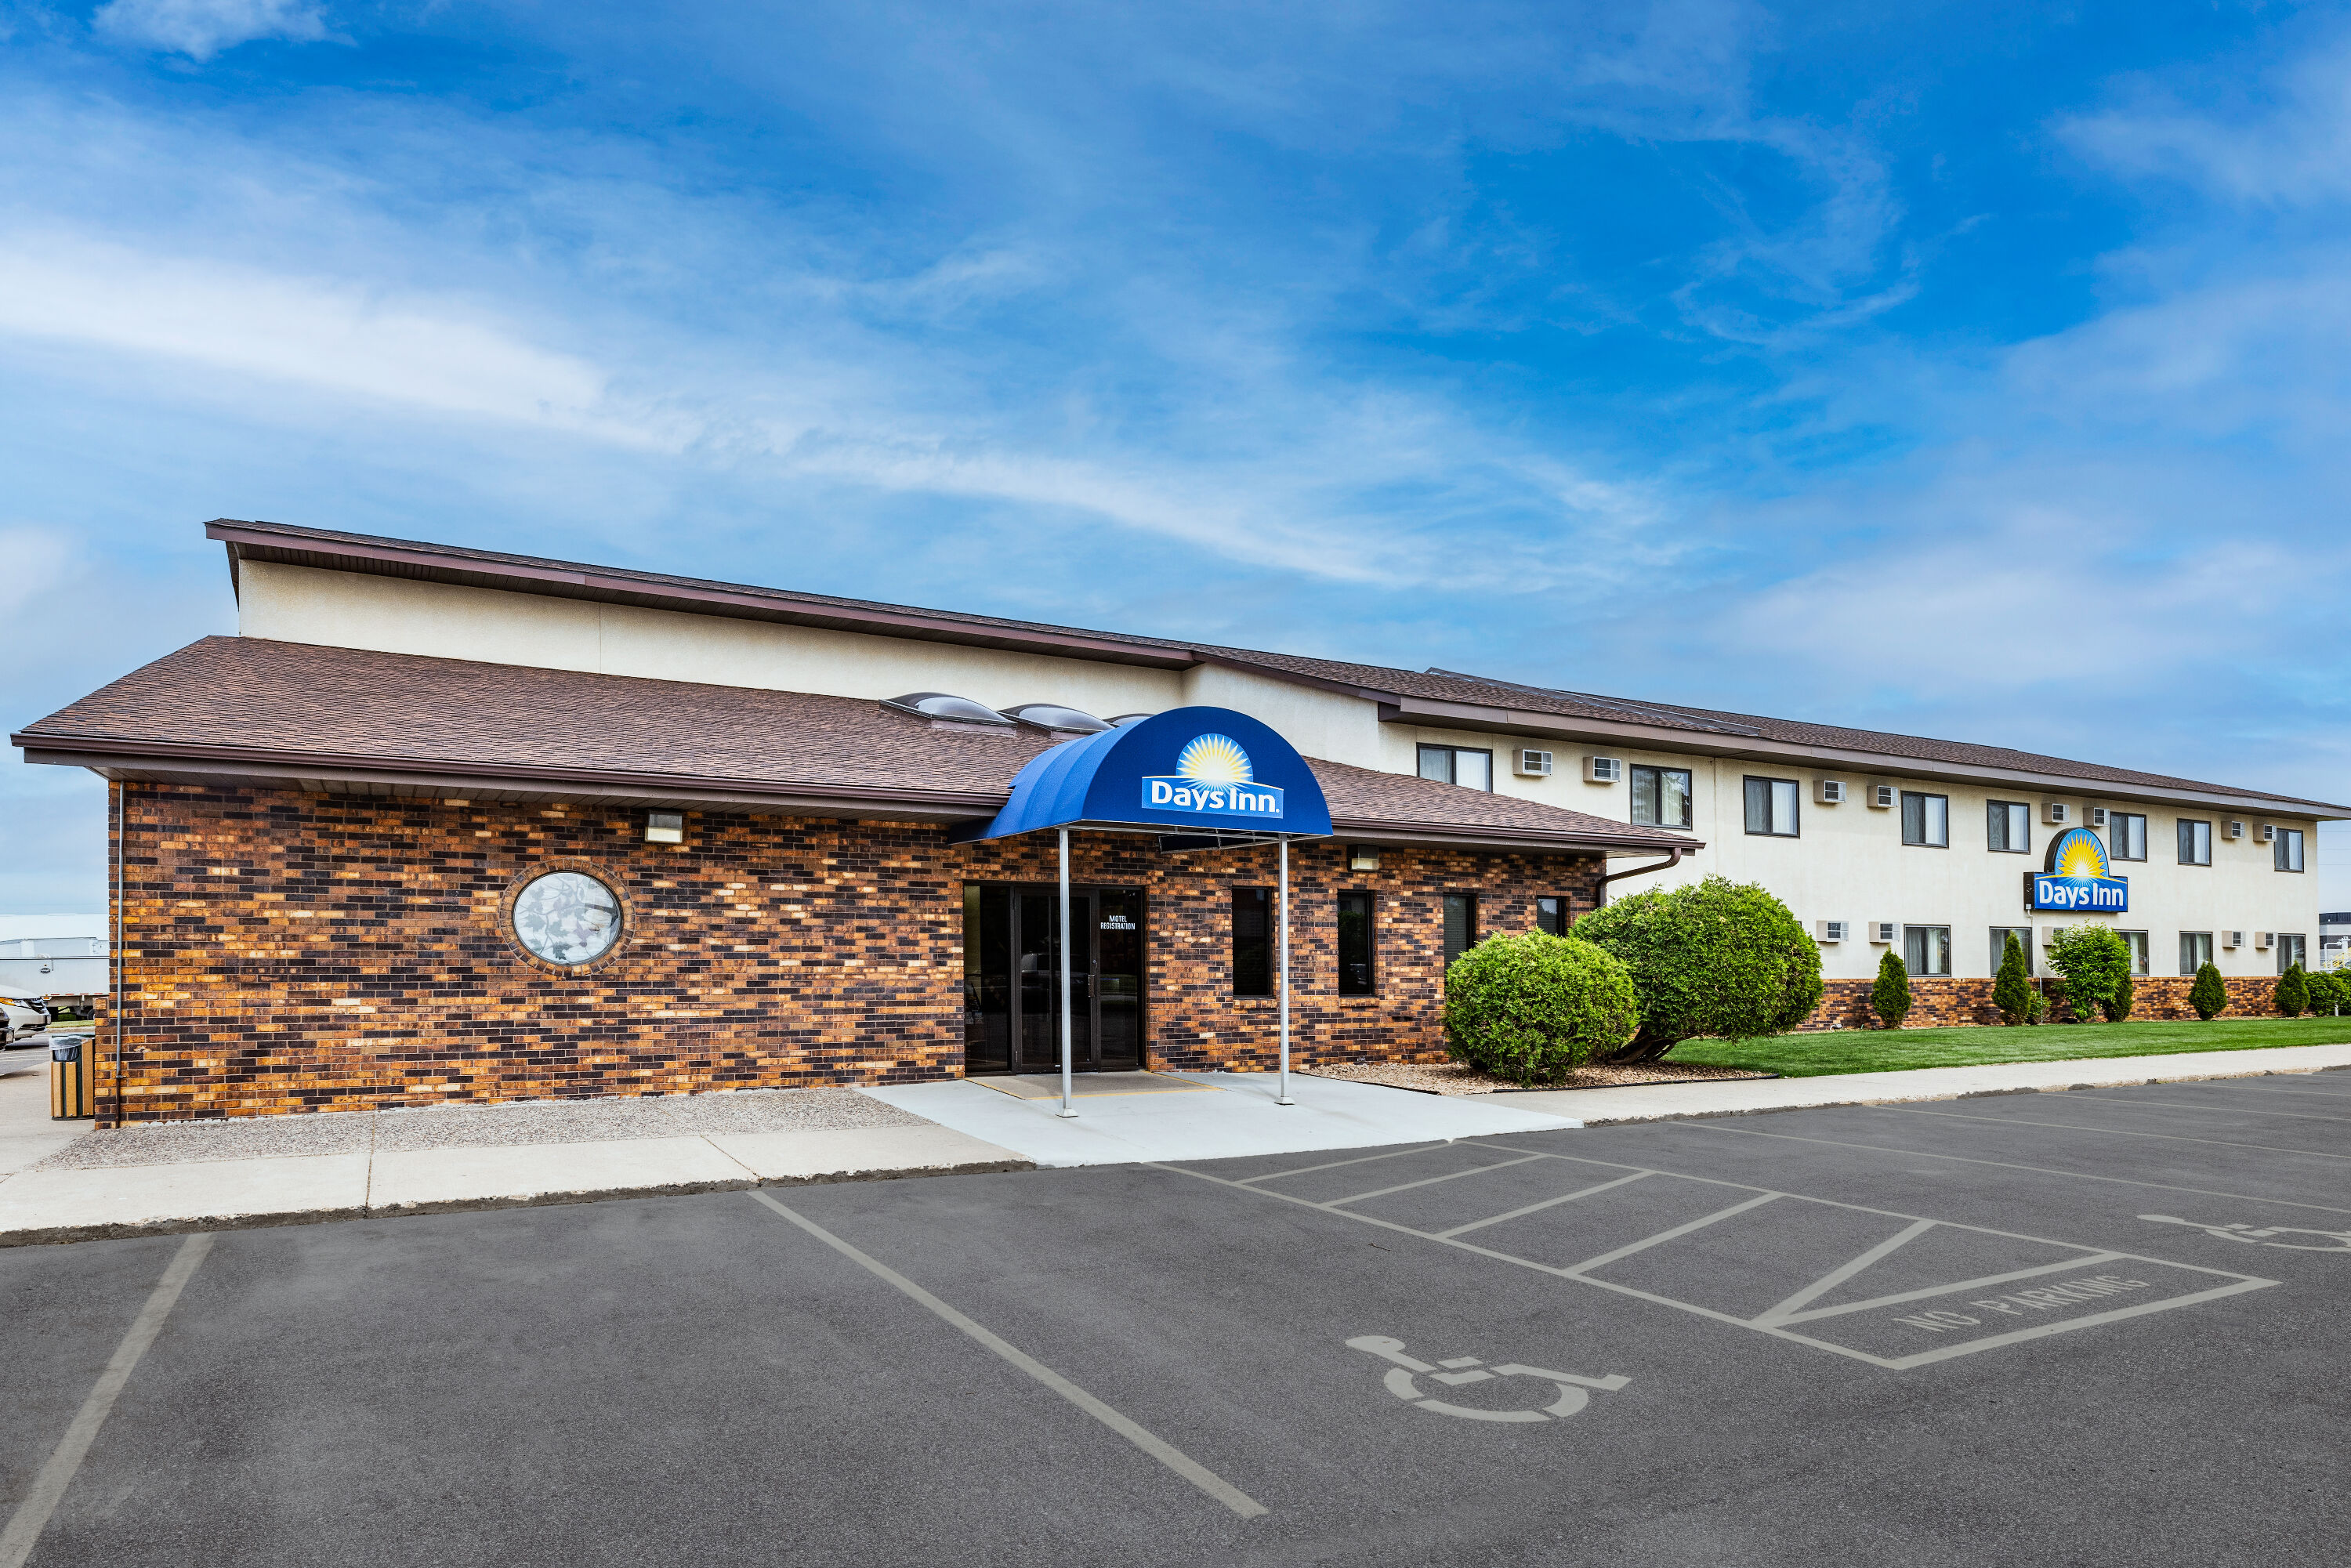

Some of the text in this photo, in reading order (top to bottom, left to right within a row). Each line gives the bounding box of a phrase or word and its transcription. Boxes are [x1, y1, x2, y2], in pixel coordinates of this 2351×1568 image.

[1151, 780, 1224, 810] Days
[2039, 881, 2124, 907] Days Inn
[1892, 1276, 2150, 1332] NO PARKING
